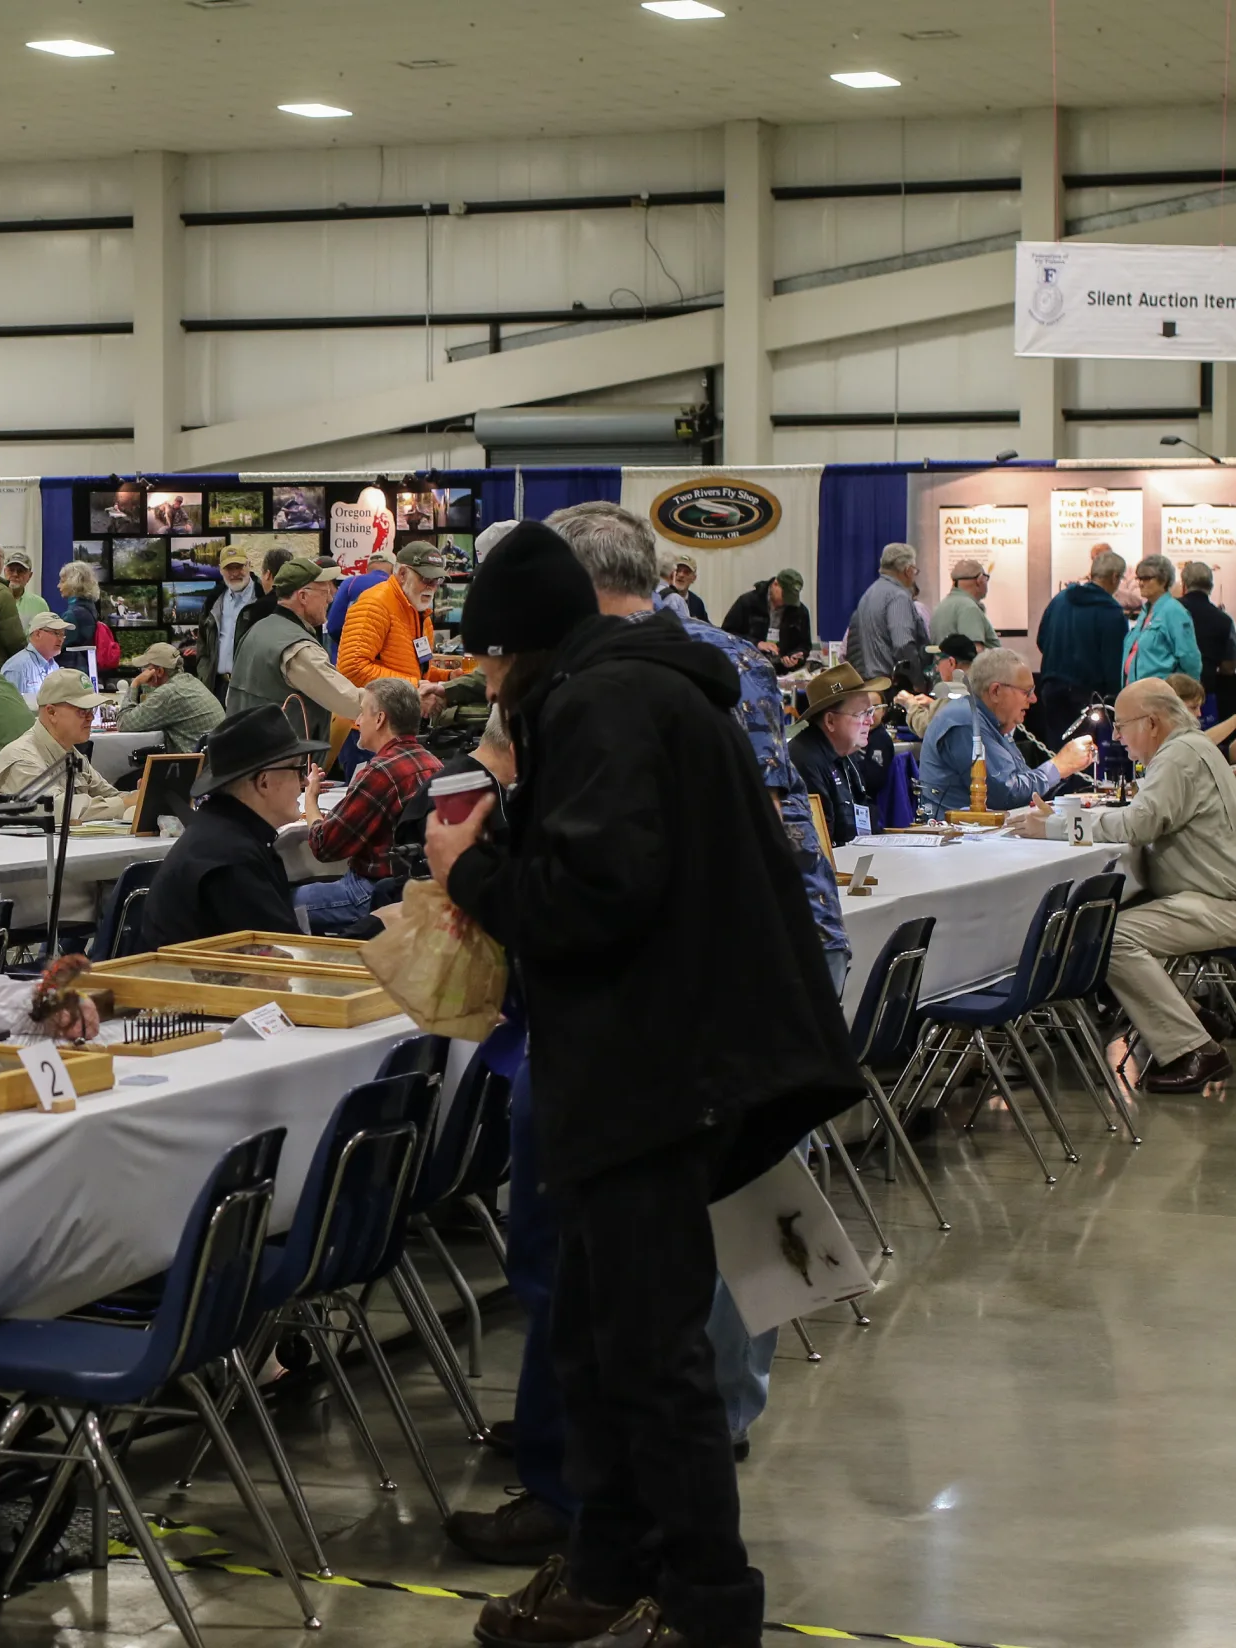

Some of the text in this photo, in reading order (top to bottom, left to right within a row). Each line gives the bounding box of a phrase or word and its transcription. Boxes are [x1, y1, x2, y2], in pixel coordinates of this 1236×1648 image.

[1044, 268, 1056, 283] F
[1087, 291, 1132, 306] Silent
[1138, 292, 1198, 308] Auction
[672, 488, 760, 505] Two Rivers Fly Shop
[1080, 499, 1115, 507] Better
[335, 508, 371, 519] Oregon
[945, 516, 960, 524] All
[335, 522, 371, 535] Fishing
[945, 527, 988, 535] Are Not
[1176, 526, 1208, 536] Rotary
[727, 531, 740, 539] OR
[334, 538, 358, 548] Club
[944, 536, 1024, 546] Created Equal.
[1074, 817, 1084, 841] 5
[41, 1061, 64, 1097] 2
